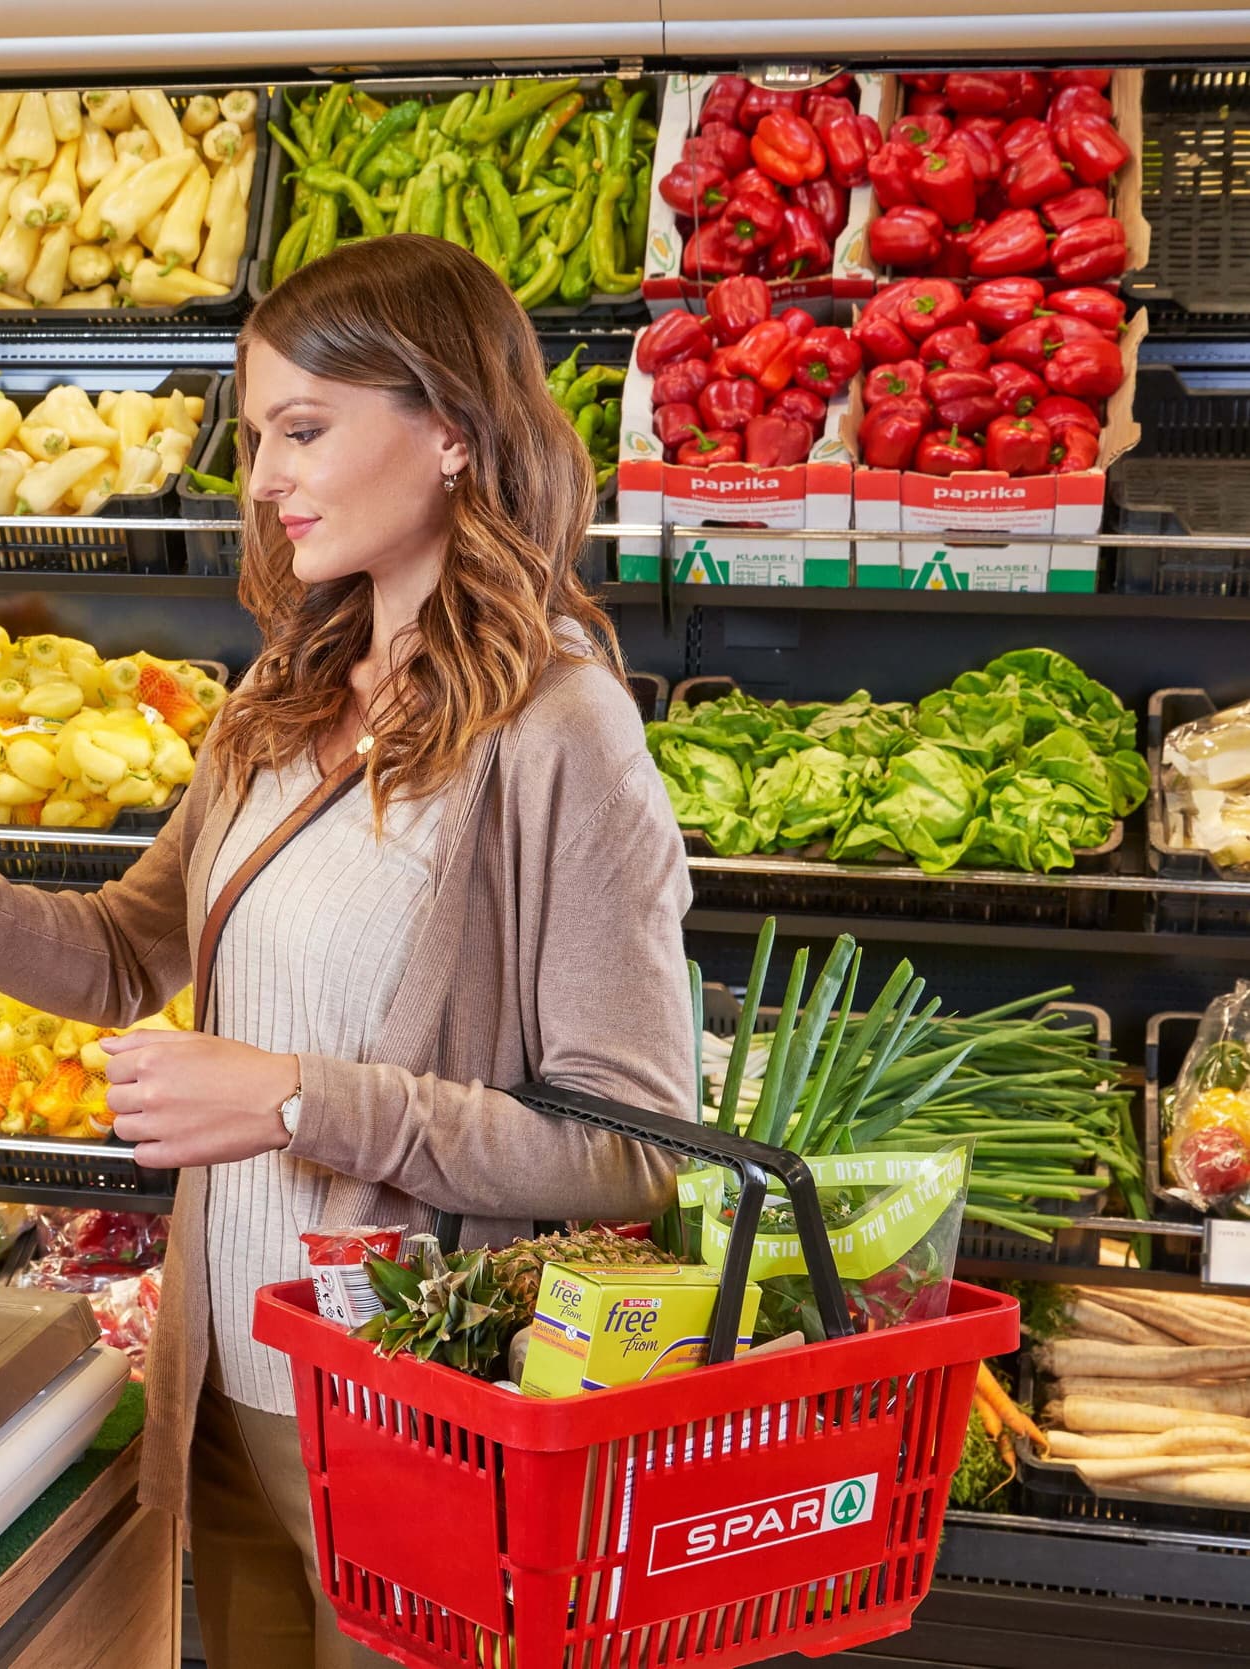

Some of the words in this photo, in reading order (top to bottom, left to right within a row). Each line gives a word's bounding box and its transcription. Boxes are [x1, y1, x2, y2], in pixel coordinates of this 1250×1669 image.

[691, 477, 780, 493] paprika
[933, 486, 1026, 502] paprika
[887, 1194, 915, 1225] TRIO
[709, 1223, 728, 1248] TR
[858, 1213, 887, 1246] TRIO
[753, 1240, 799, 1257] TRIO
[550, 1280, 582, 1307] free
[558, 1304, 582, 1321] from
[604, 1302, 657, 1332] free
[620, 1332, 659, 1358] from
[686, 1498, 820, 1556] SPAR
